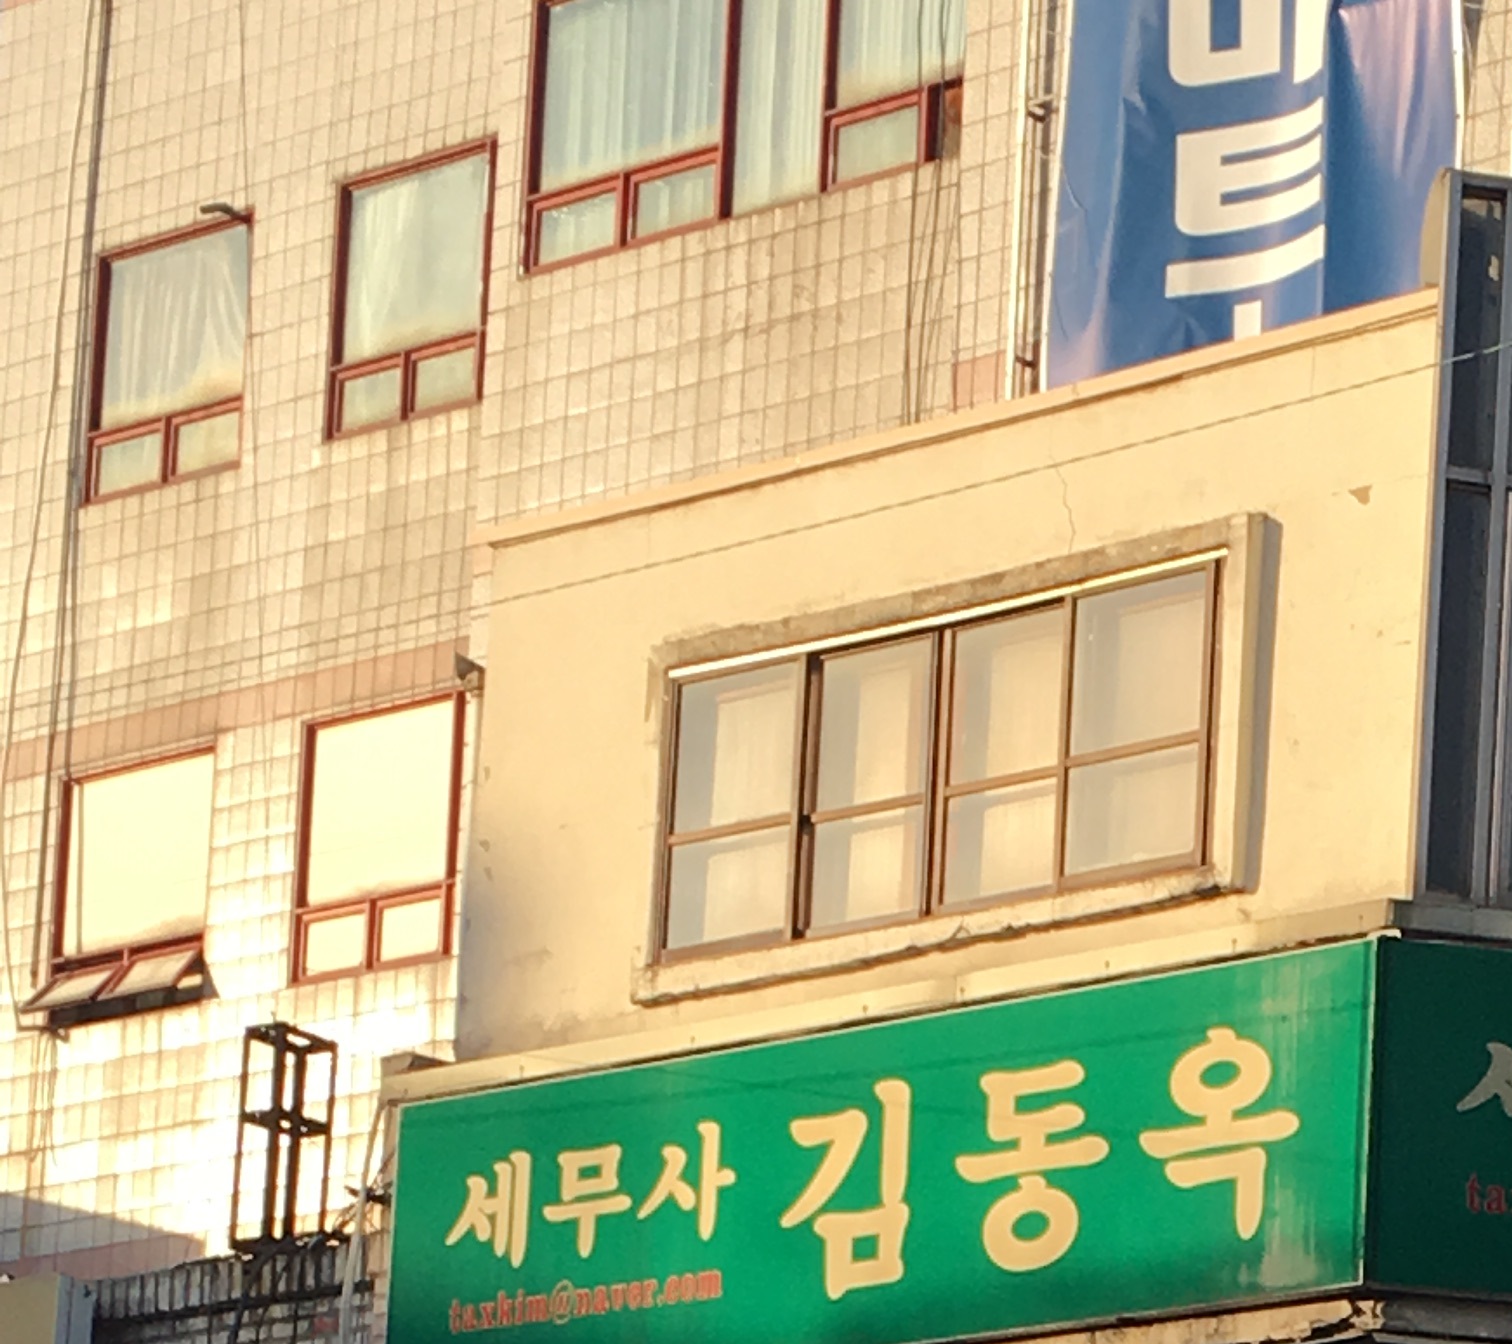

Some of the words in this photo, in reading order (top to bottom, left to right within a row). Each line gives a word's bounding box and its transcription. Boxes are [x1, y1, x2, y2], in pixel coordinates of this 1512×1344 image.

[445, 1119, 737, 1269] 세무사
[780, 1026, 1301, 1300] 김동옥
[449, 1268, 723, 1336] taxkim@naver.com
